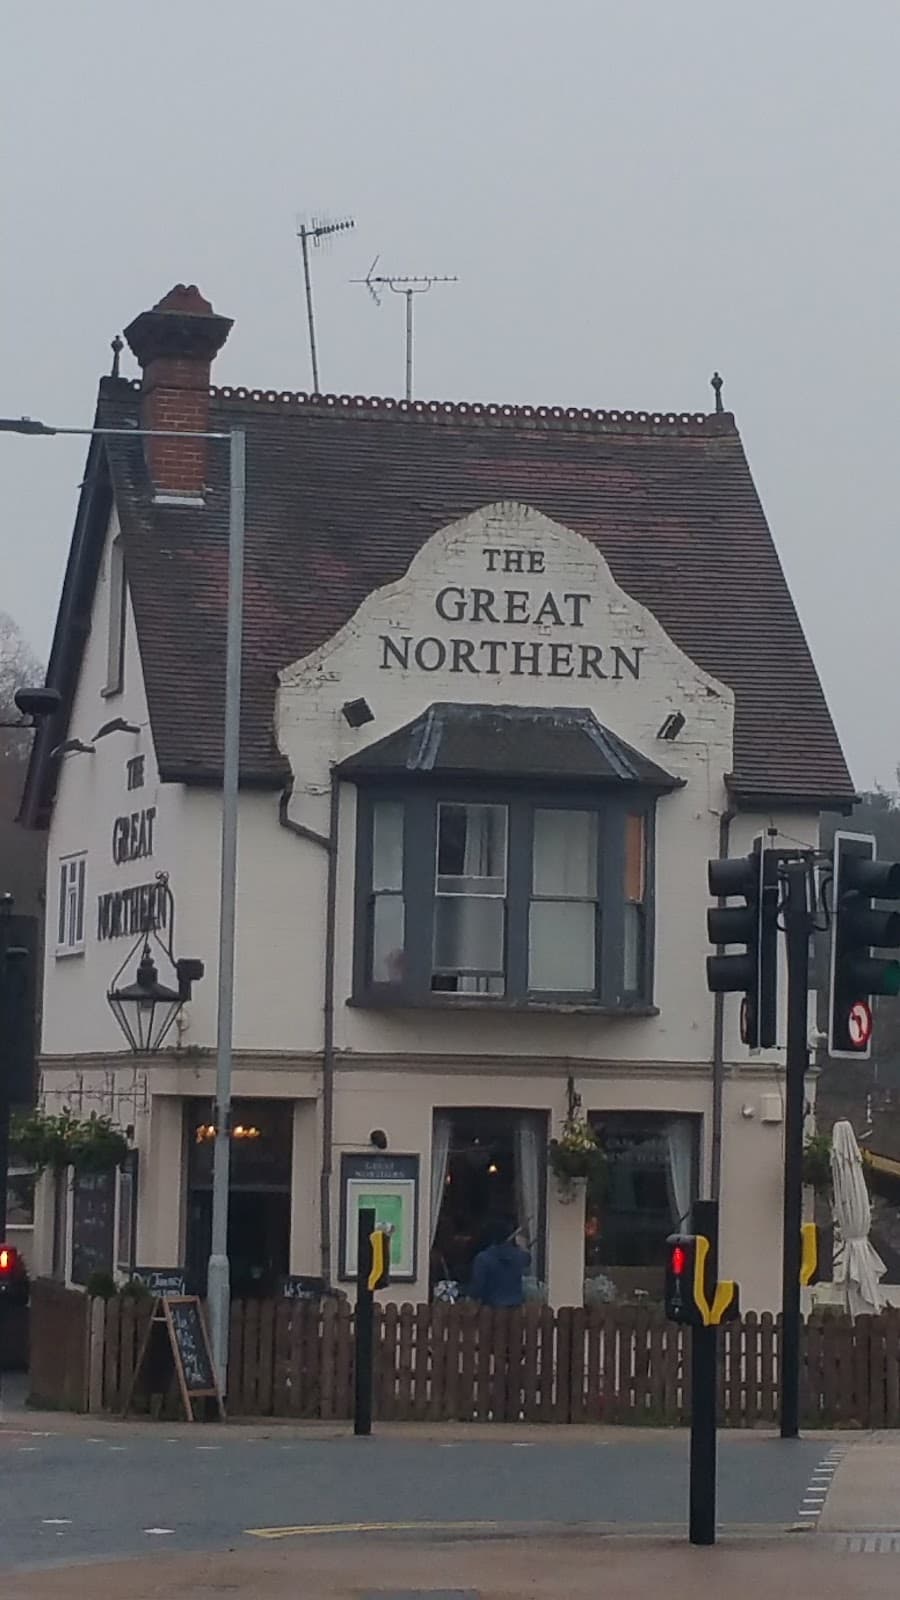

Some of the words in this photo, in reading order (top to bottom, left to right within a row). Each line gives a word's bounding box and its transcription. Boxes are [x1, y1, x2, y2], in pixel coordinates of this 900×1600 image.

[483, 549, 545, 573] THE
[435, 587, 591, 626] GREAT
[378, 635, 645, 680] NORTHERN
[113, 806, 156, 866] GREAT
[98, 883, 167, 942] NORTHERN
